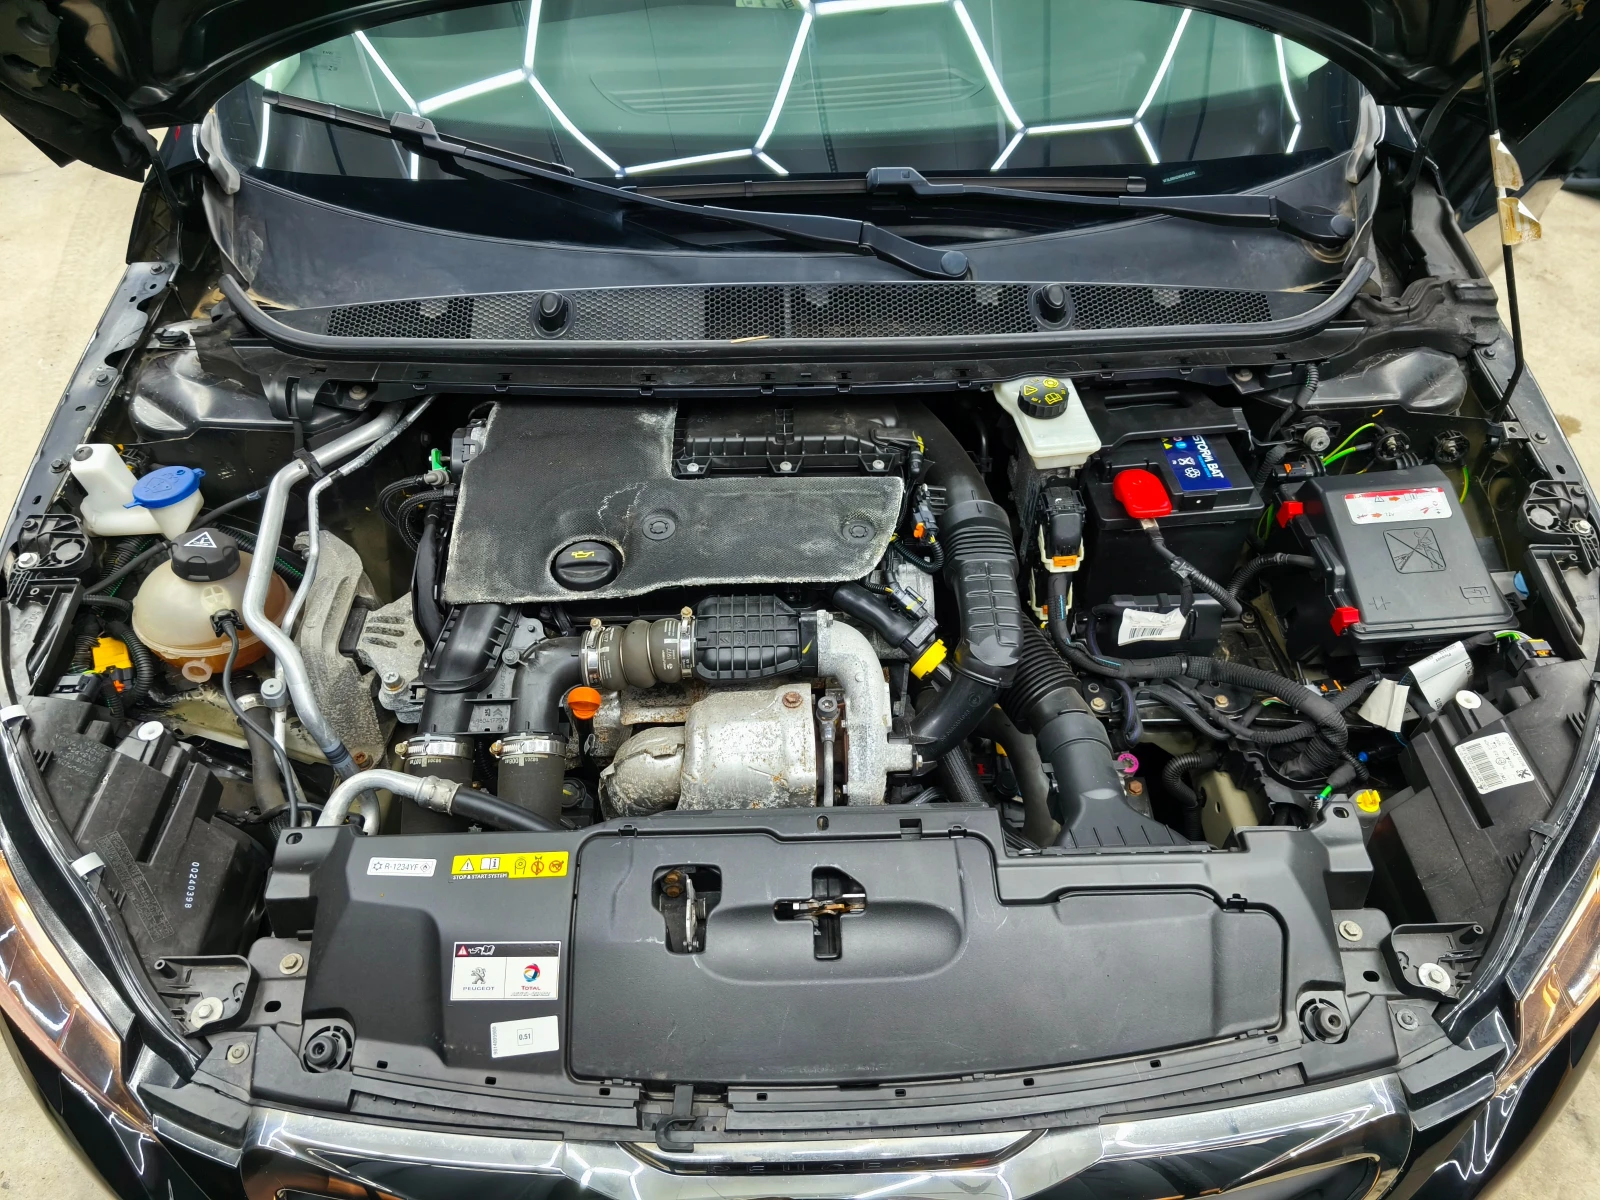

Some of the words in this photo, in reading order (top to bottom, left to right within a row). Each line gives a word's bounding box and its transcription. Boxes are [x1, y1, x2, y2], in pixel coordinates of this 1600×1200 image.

[1192, 435, 1214, 462] STORM
[1206, 463, 1224, 478] BAT
[384, 863, 419, 871] R-1234YF
[184, 861, 200, 909] 00240398
[518, 1033, 531, 1041] 0.51
[706, 1158, 960, 1175] PEUGEOT
